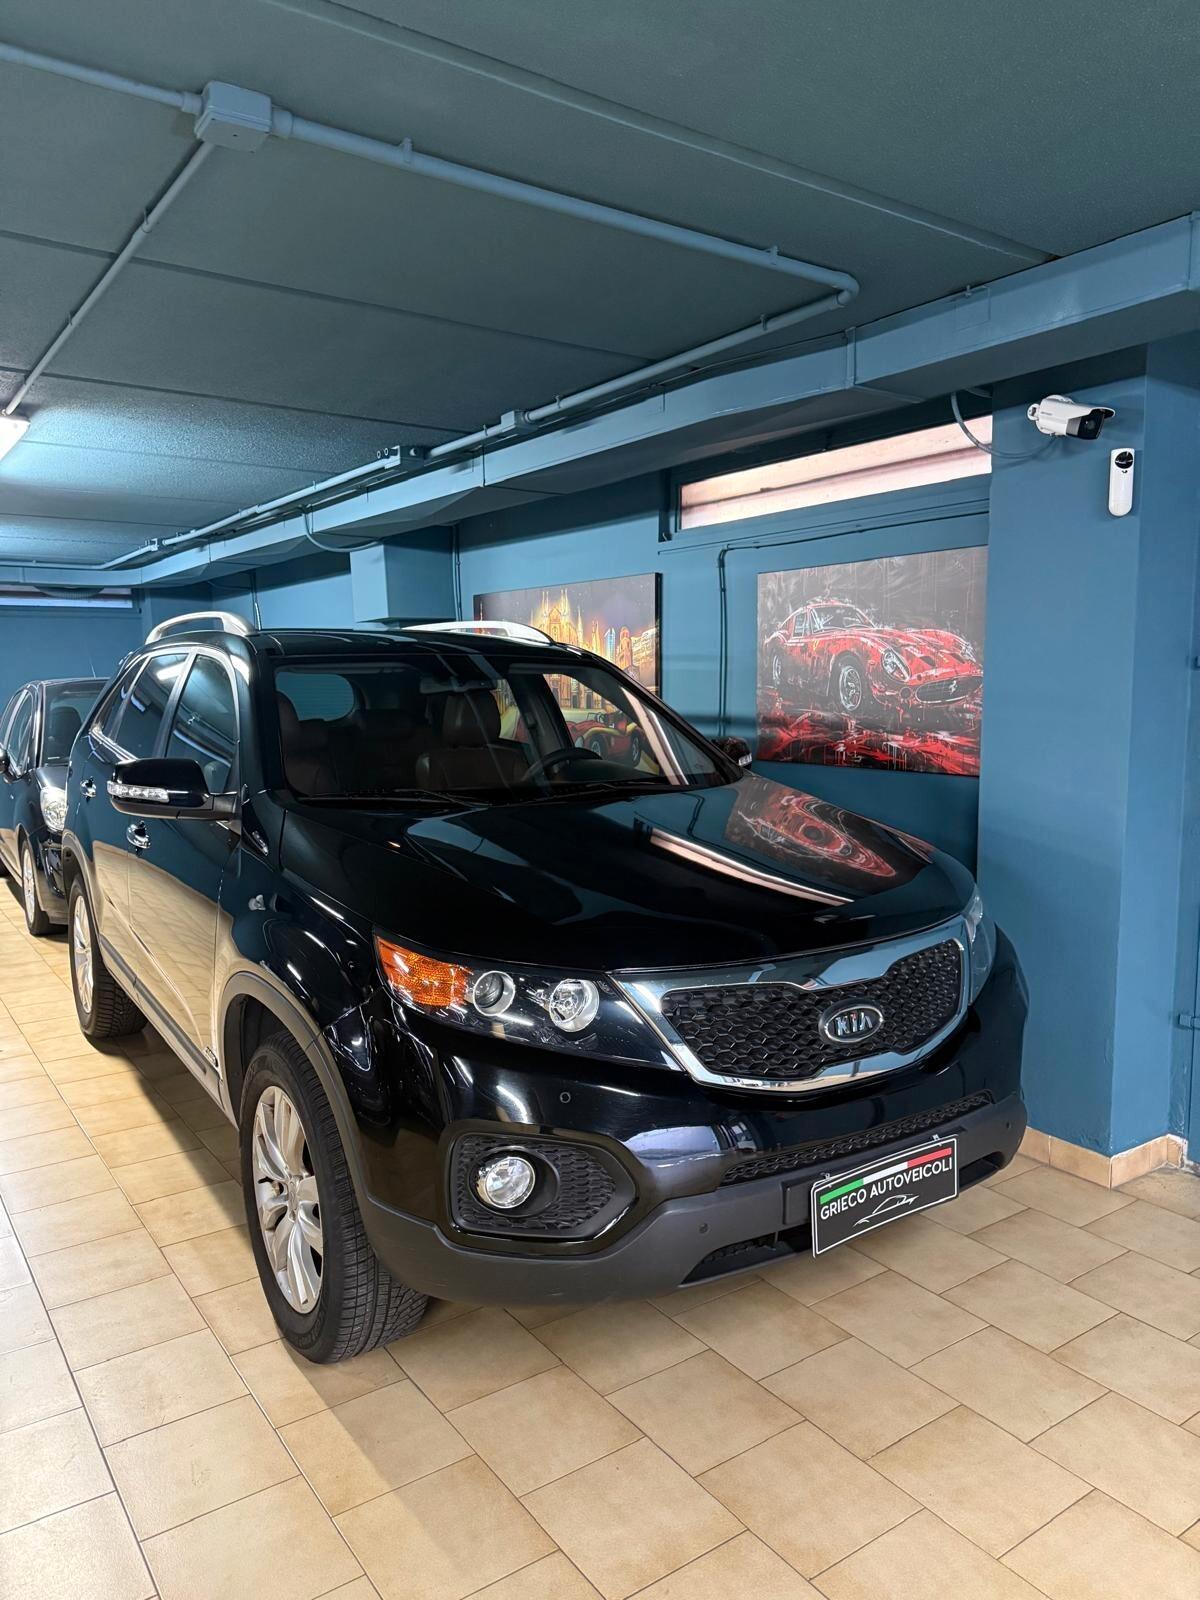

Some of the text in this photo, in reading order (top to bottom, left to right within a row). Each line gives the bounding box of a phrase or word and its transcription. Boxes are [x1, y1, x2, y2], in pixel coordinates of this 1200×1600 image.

[835, 1012, 873, 1036] KIA
[820, 1157, 953, 1220] GRIECO AUTOVEICOLI
